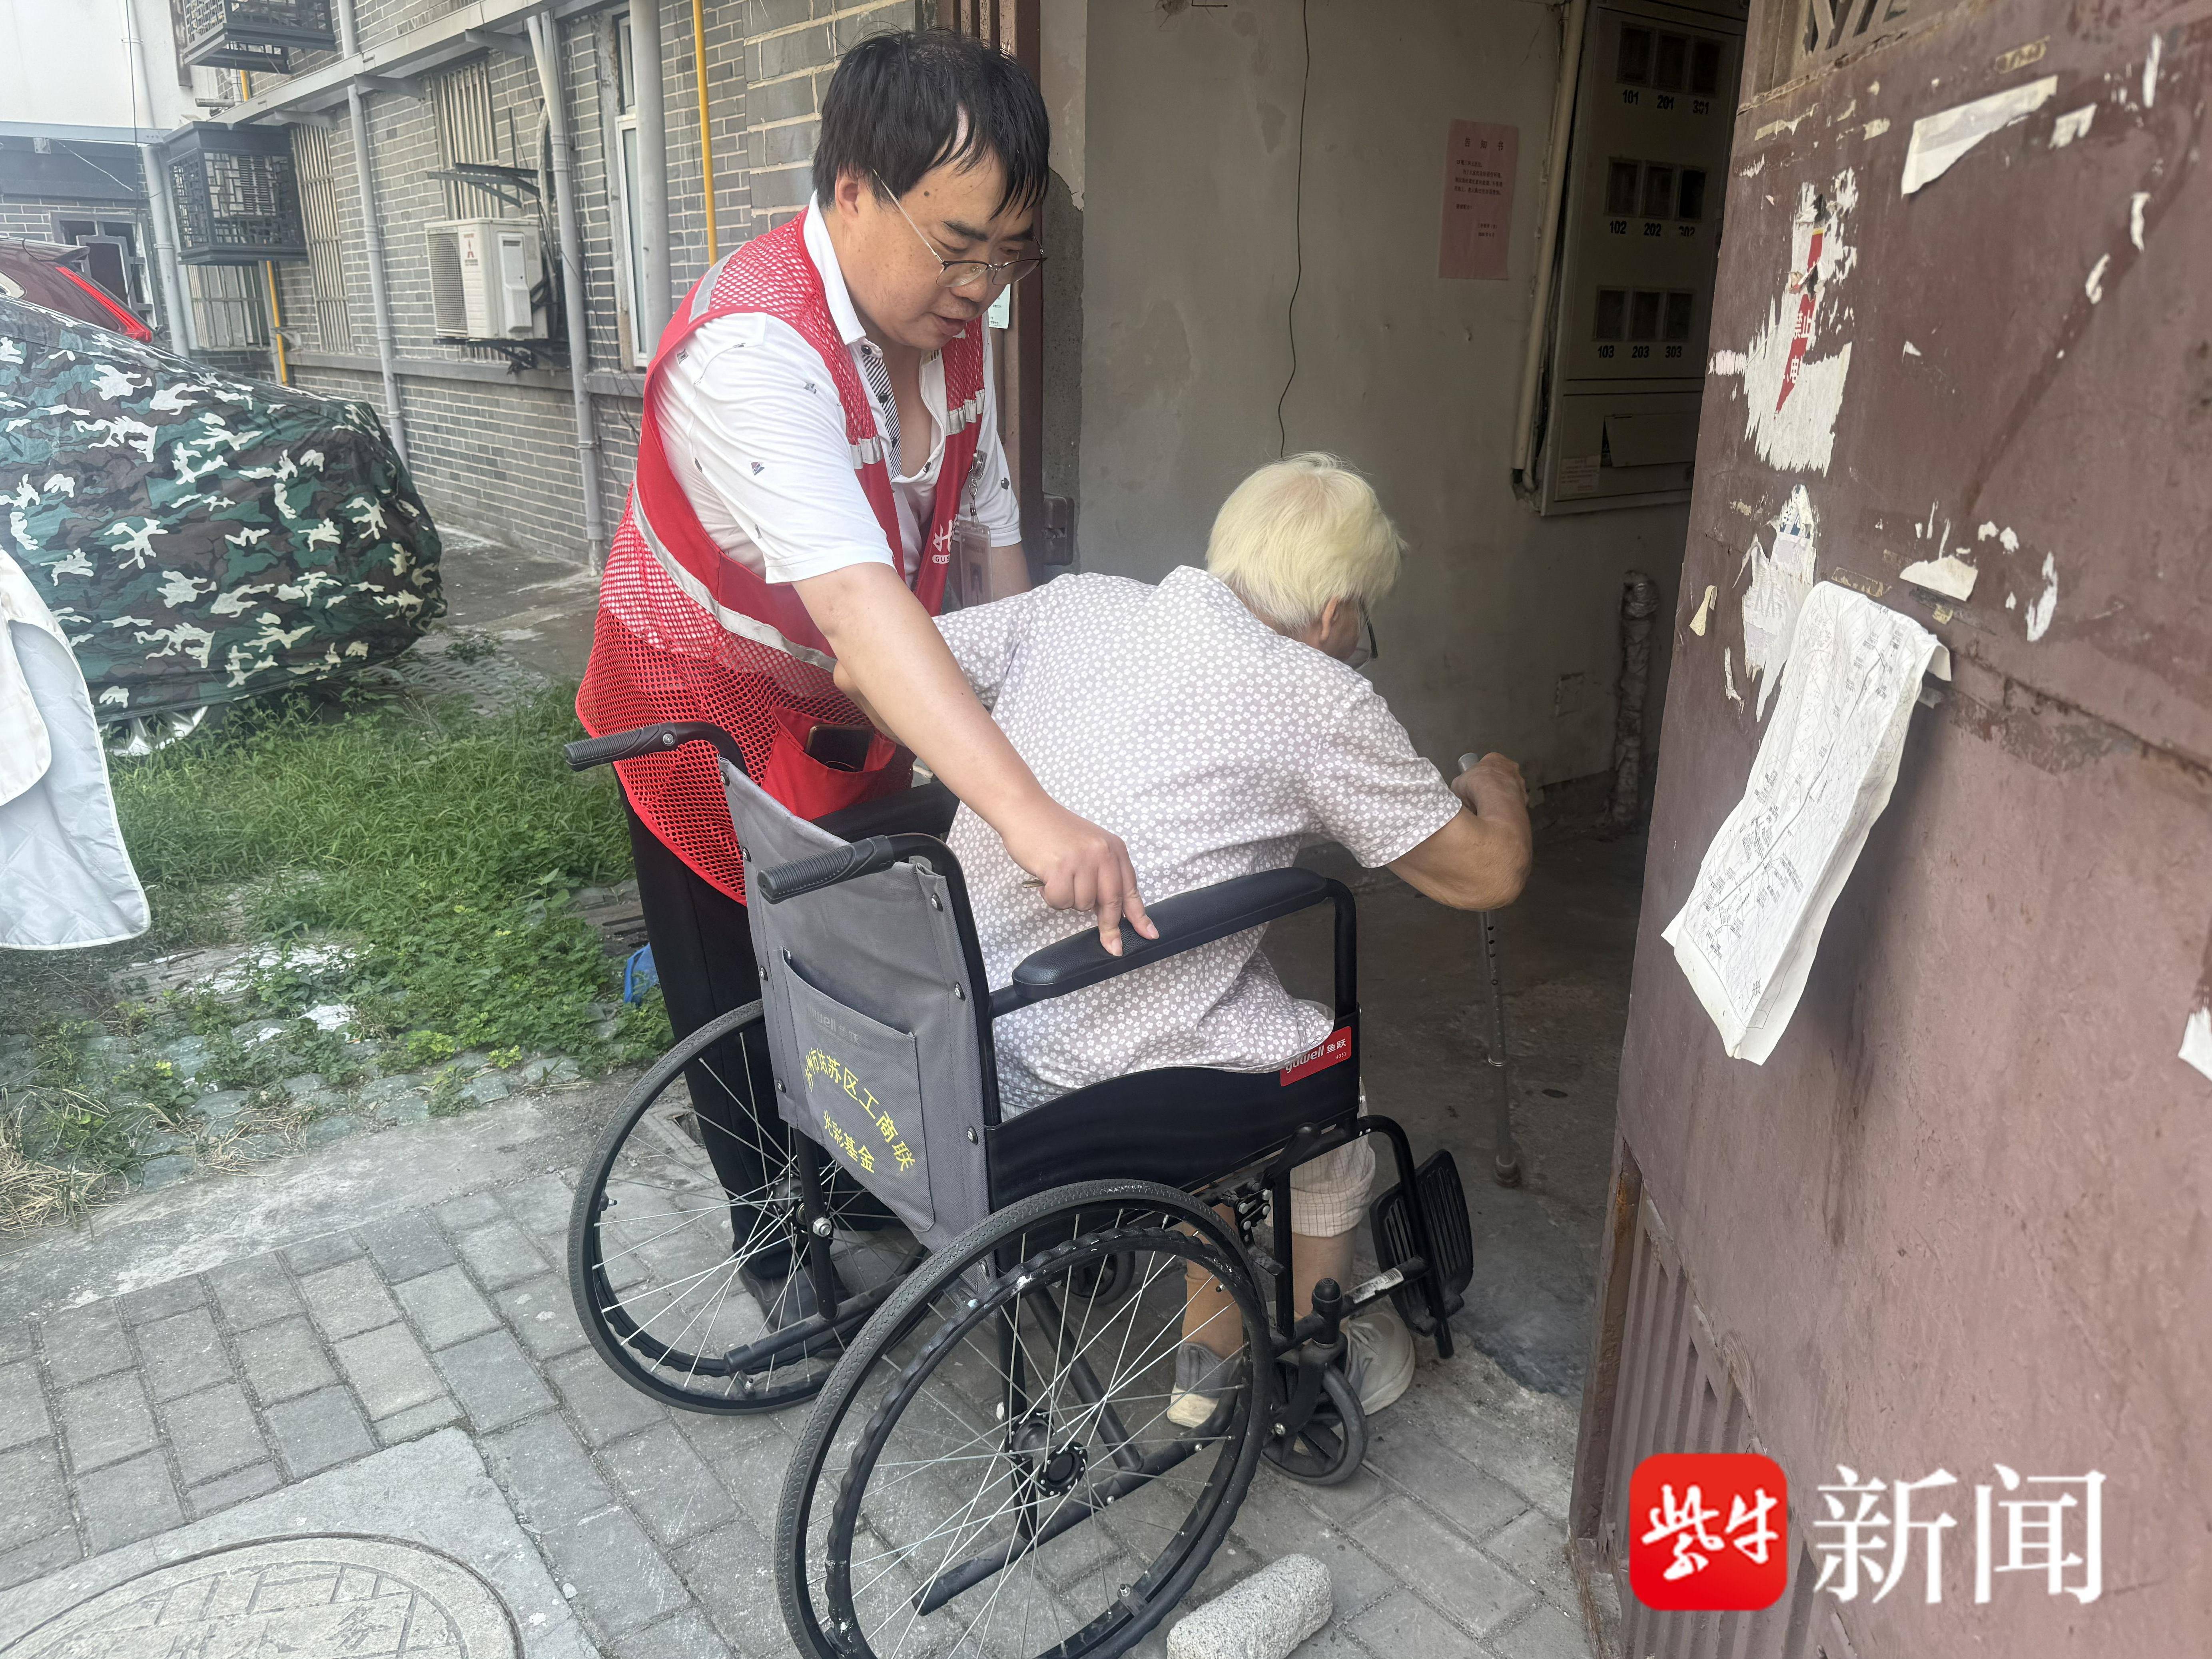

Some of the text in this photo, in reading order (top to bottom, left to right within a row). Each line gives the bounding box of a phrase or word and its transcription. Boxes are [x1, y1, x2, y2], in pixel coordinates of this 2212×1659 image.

[1622, 89, 1709, 114] 101 201 301
[1464, 137, 1504, 152] 告知书
[1610, 221, 1695, 237] 102 202 302
[1598, 345, 1682, 358] 103 203 303
[807, 1004, 836, 1032] well
[1326, 1038, 1346, 1054] 鱼跃
[805, 1047, 916, 1172] 苏州市姑苏区工商联
[823, 1110, 876, 1174] 光彩基金
